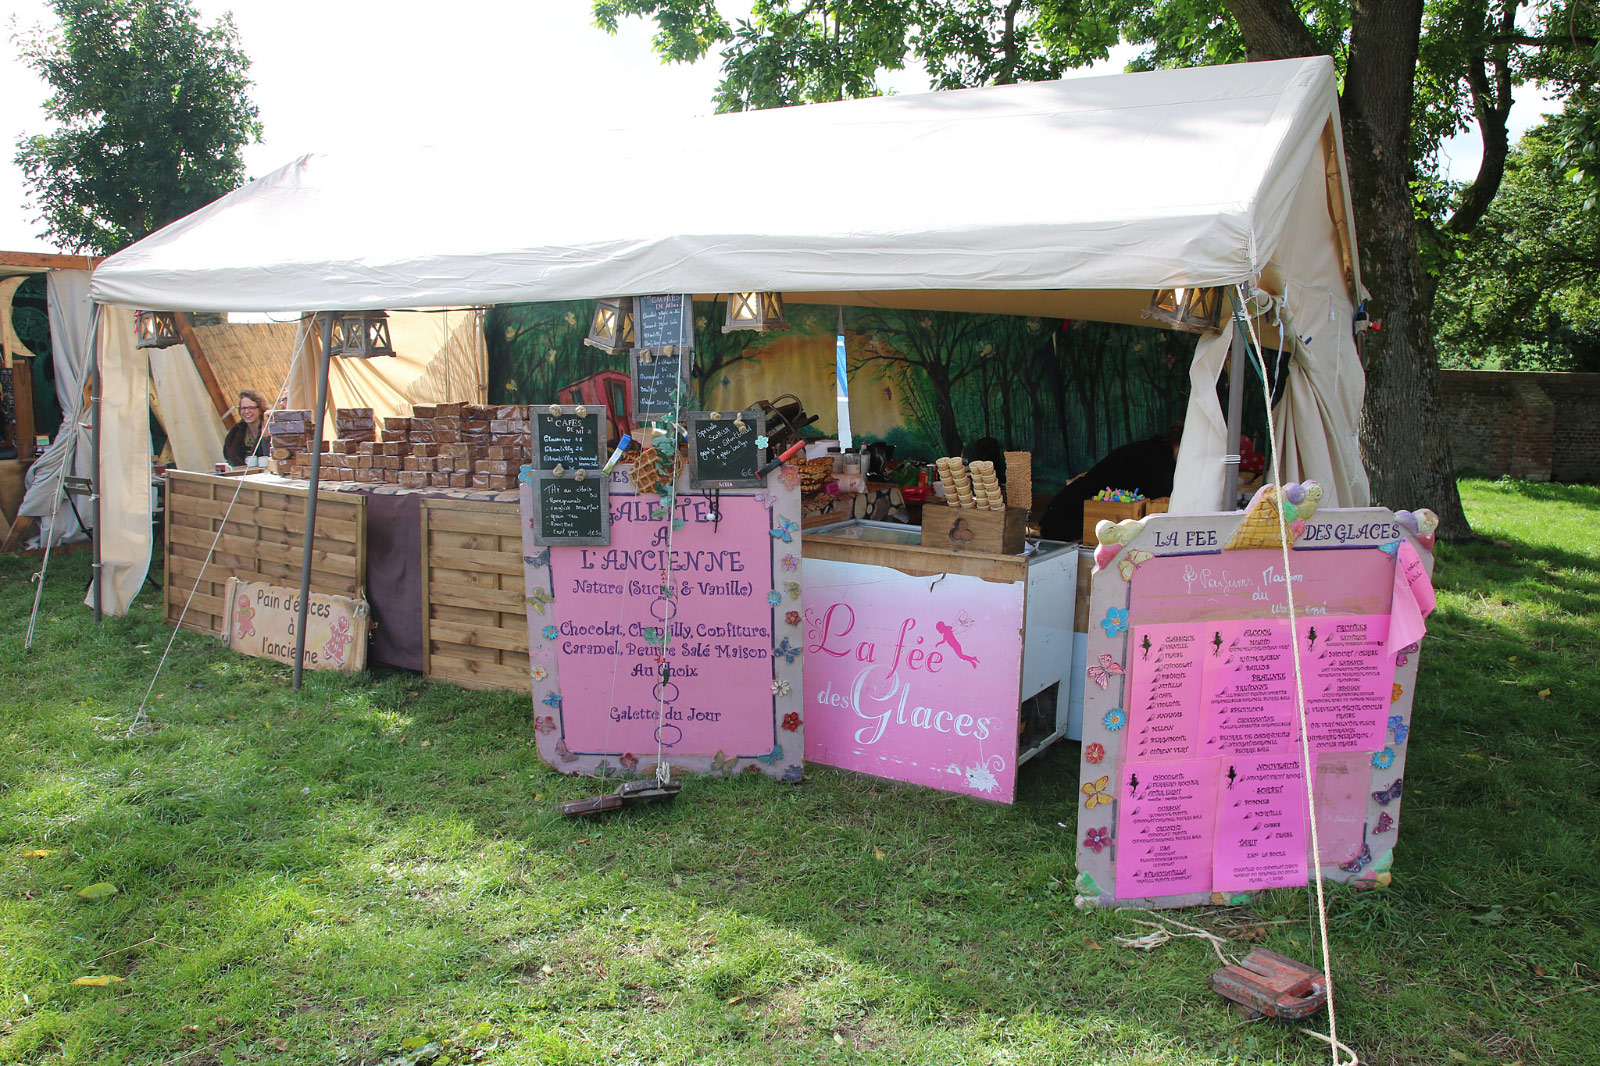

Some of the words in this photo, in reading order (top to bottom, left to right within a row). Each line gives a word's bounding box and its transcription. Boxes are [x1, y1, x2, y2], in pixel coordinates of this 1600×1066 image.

[1154, 530, 1179, 548] LA
[1185, 529, 1218, 548] FEE
[1302, 523, 1332, 541] DES
[1334, 522, 1401, 544] GLACES
[581, 549, 745, 573] L'ANCIENNE
[572, 579, 624, 598] Nature
[628, 578, 675, 598] (Sucre
[680, 581, 695, 597] &
[697, 580, 753, 598] Vanille)
[1199, 567, 1254, 594] Parfums
[1262, 565, 1304, 587] Maion
[1251, 585, 1270, 601] du
[256, 588, 280, 609] Pain
[283, 594, 331, 619] d'éices
[287, 617, 295, 636] à
[560, 620, 626, 638] Chocolat,
[628, 621, 694, 640] Chnilly,
[696, 622, 770, 639] Confiture,
[804, 602, 877, 663] La
[1243, 628, 1273, 638] ALCOOL
[262, 636, 319, 665] l'anciene
[562, 640, 624, 657] Caramel,
[626, 642, 676, 657] Beurre
[681, 641, 710, 658] Salé
[714, 643, 768, 659] Maison
[631, 662, 654, 677] Au
[1163, 661, 1193, 670] CHOCOLAT
[817, 680, 850, 710] des
[850, 663, 992, 745] Glaces
[609, 705, 660, 723] Galette
[664, 706, 683, 721] du
[686, 707, 723, 722] Jour
[1173, 746, 1189, 754] VERT
[1238, 838, 1258, 848] TARIF
